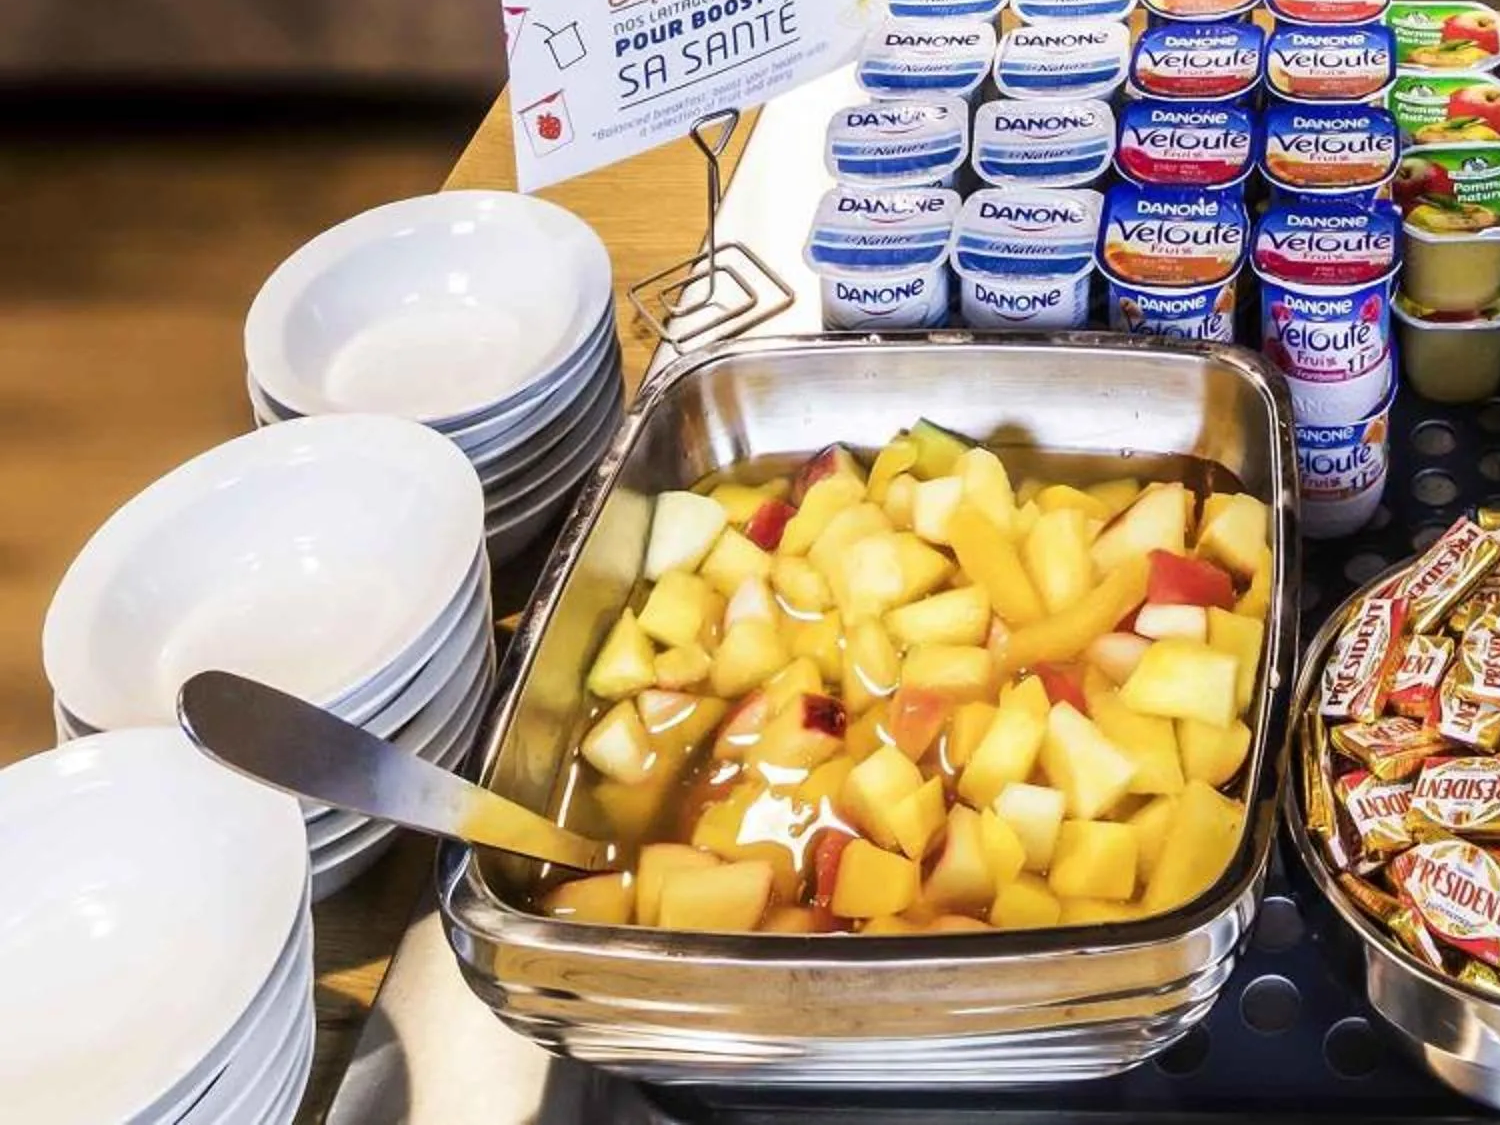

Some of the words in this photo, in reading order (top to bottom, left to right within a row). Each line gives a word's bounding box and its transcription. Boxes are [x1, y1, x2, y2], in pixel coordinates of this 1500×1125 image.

[614, 13, 644, 35] NOS
[615, 18, 683, 58] POUR
[885, 34, 981, 46] DANONE
[1165, 35, 1239, 46] DANONE
[1293, 34, 1365, 46] DANONE
[618, 54, 667, 99] SA
[1152, 110, 1229, 124] DANONE
[1293, 116, 1371, 129] DANONE
[1137, 200, 1219, 216] DANONE
[1287, 214, 1368, 227] DANONE
[836, 278, 925, 304] DANONE
[975, 283, 1061, 309] DANONE
[1284, 295, 1353, 316] DANONE
[1297, 427, 1354, 442] ANONE
[1298, 444, 1371, 474] elouté
[1327, 604, 1384, 706] PRÉSIDENT
